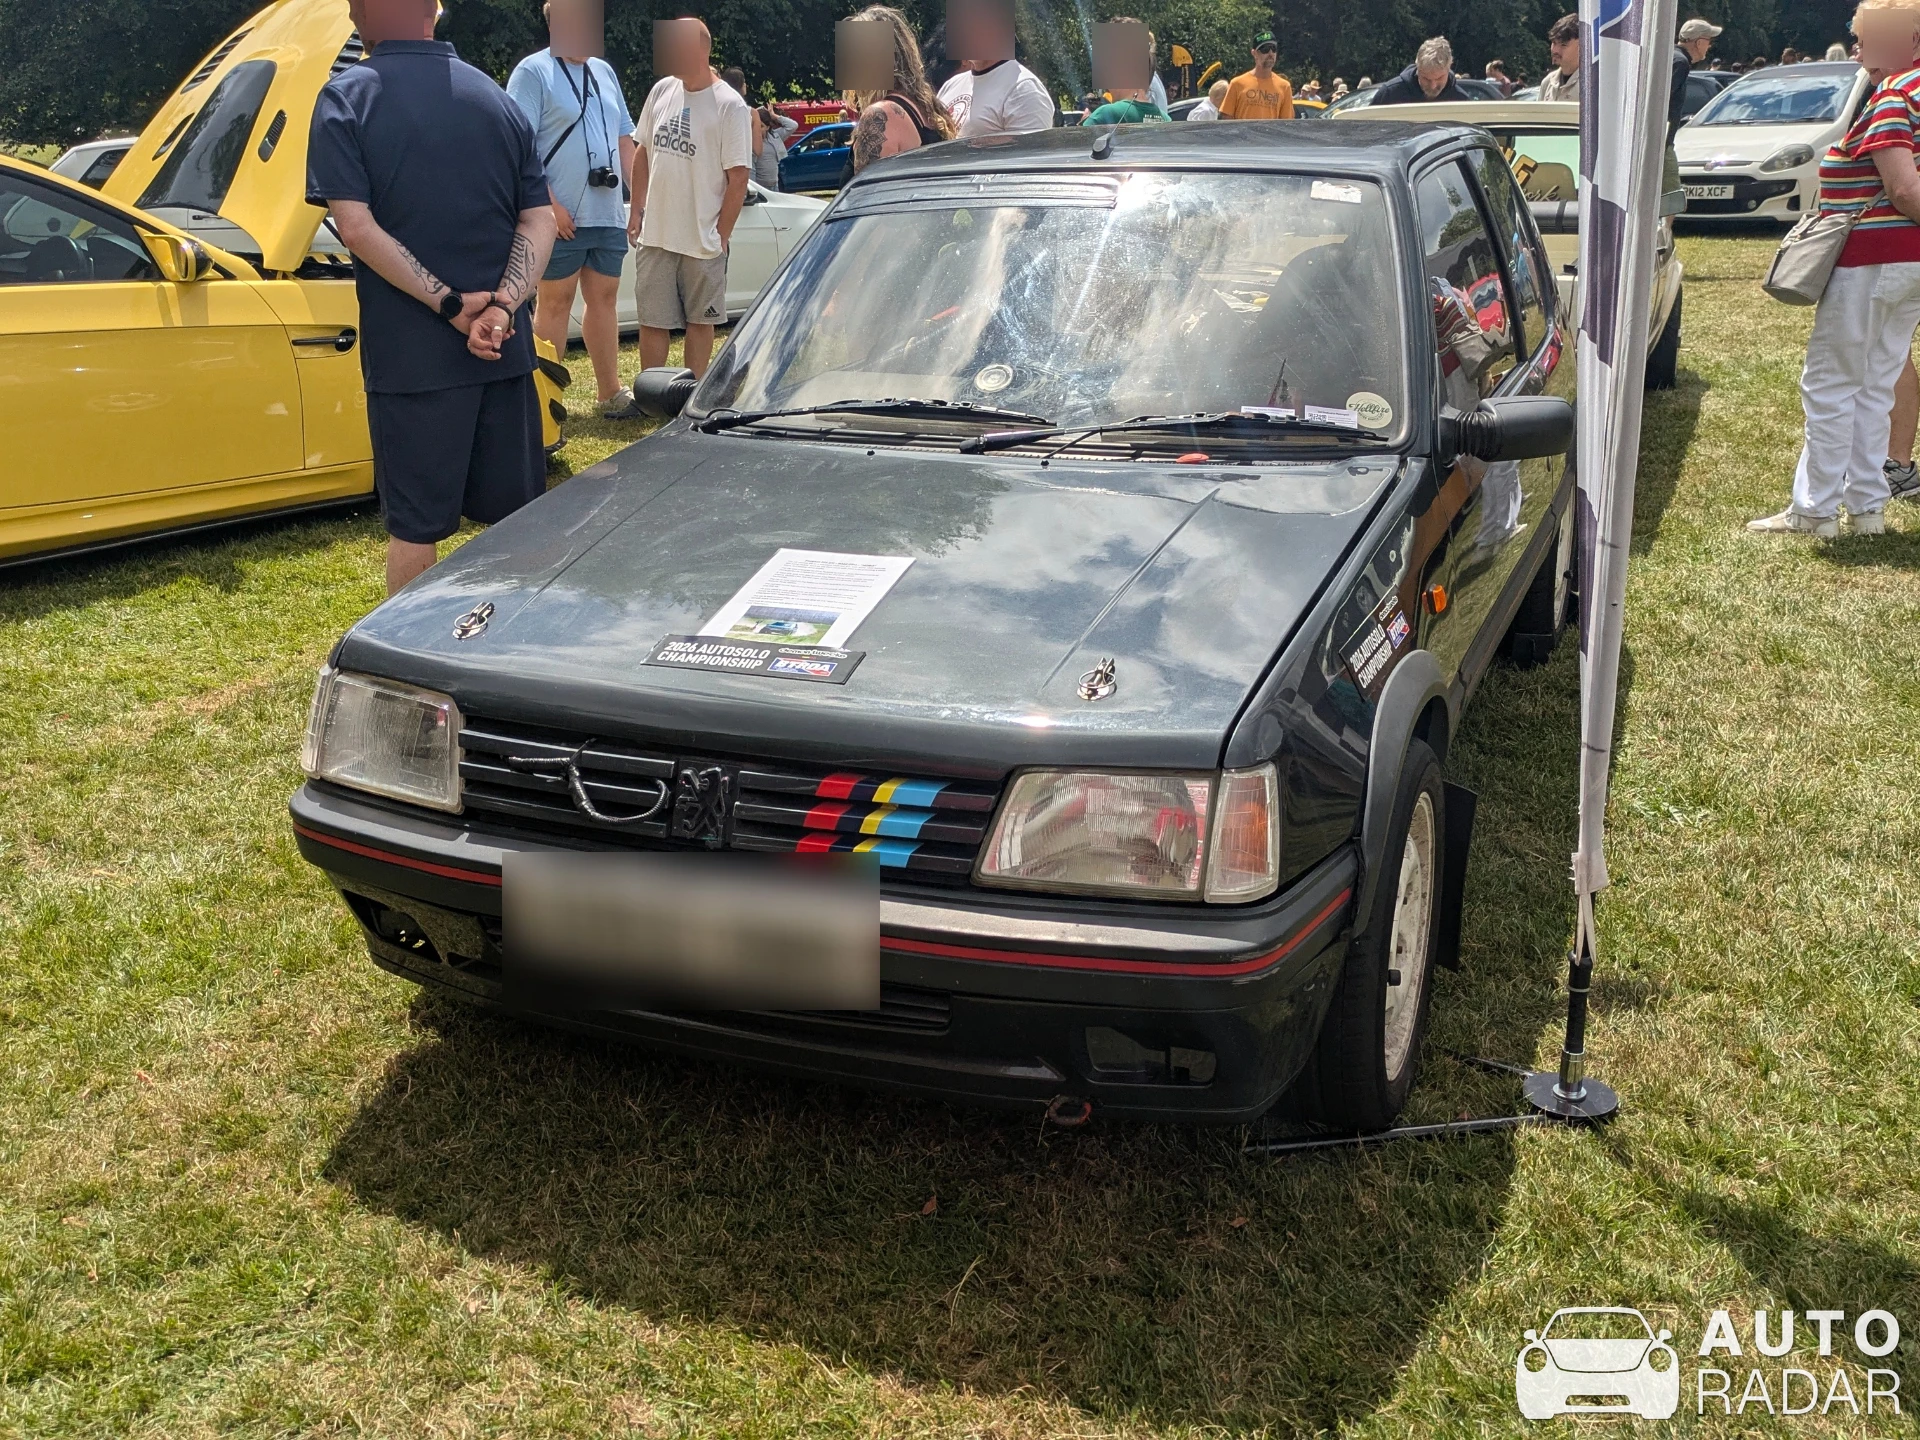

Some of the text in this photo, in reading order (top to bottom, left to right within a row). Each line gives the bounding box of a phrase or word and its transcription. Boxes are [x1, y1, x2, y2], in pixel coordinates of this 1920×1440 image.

[654, 132, 697, 156] adidas
[1707, 187, 1728, 197] XCF
[664, 642, 771, 659] 2026 AUTOSOLO
[1360, 624, 1386, 660] AUTOSOLO
[657, 651, 764, 669] CHAMPIONSHIP
[1358, 640, 1392, 688] CHAMPIONSHIP
